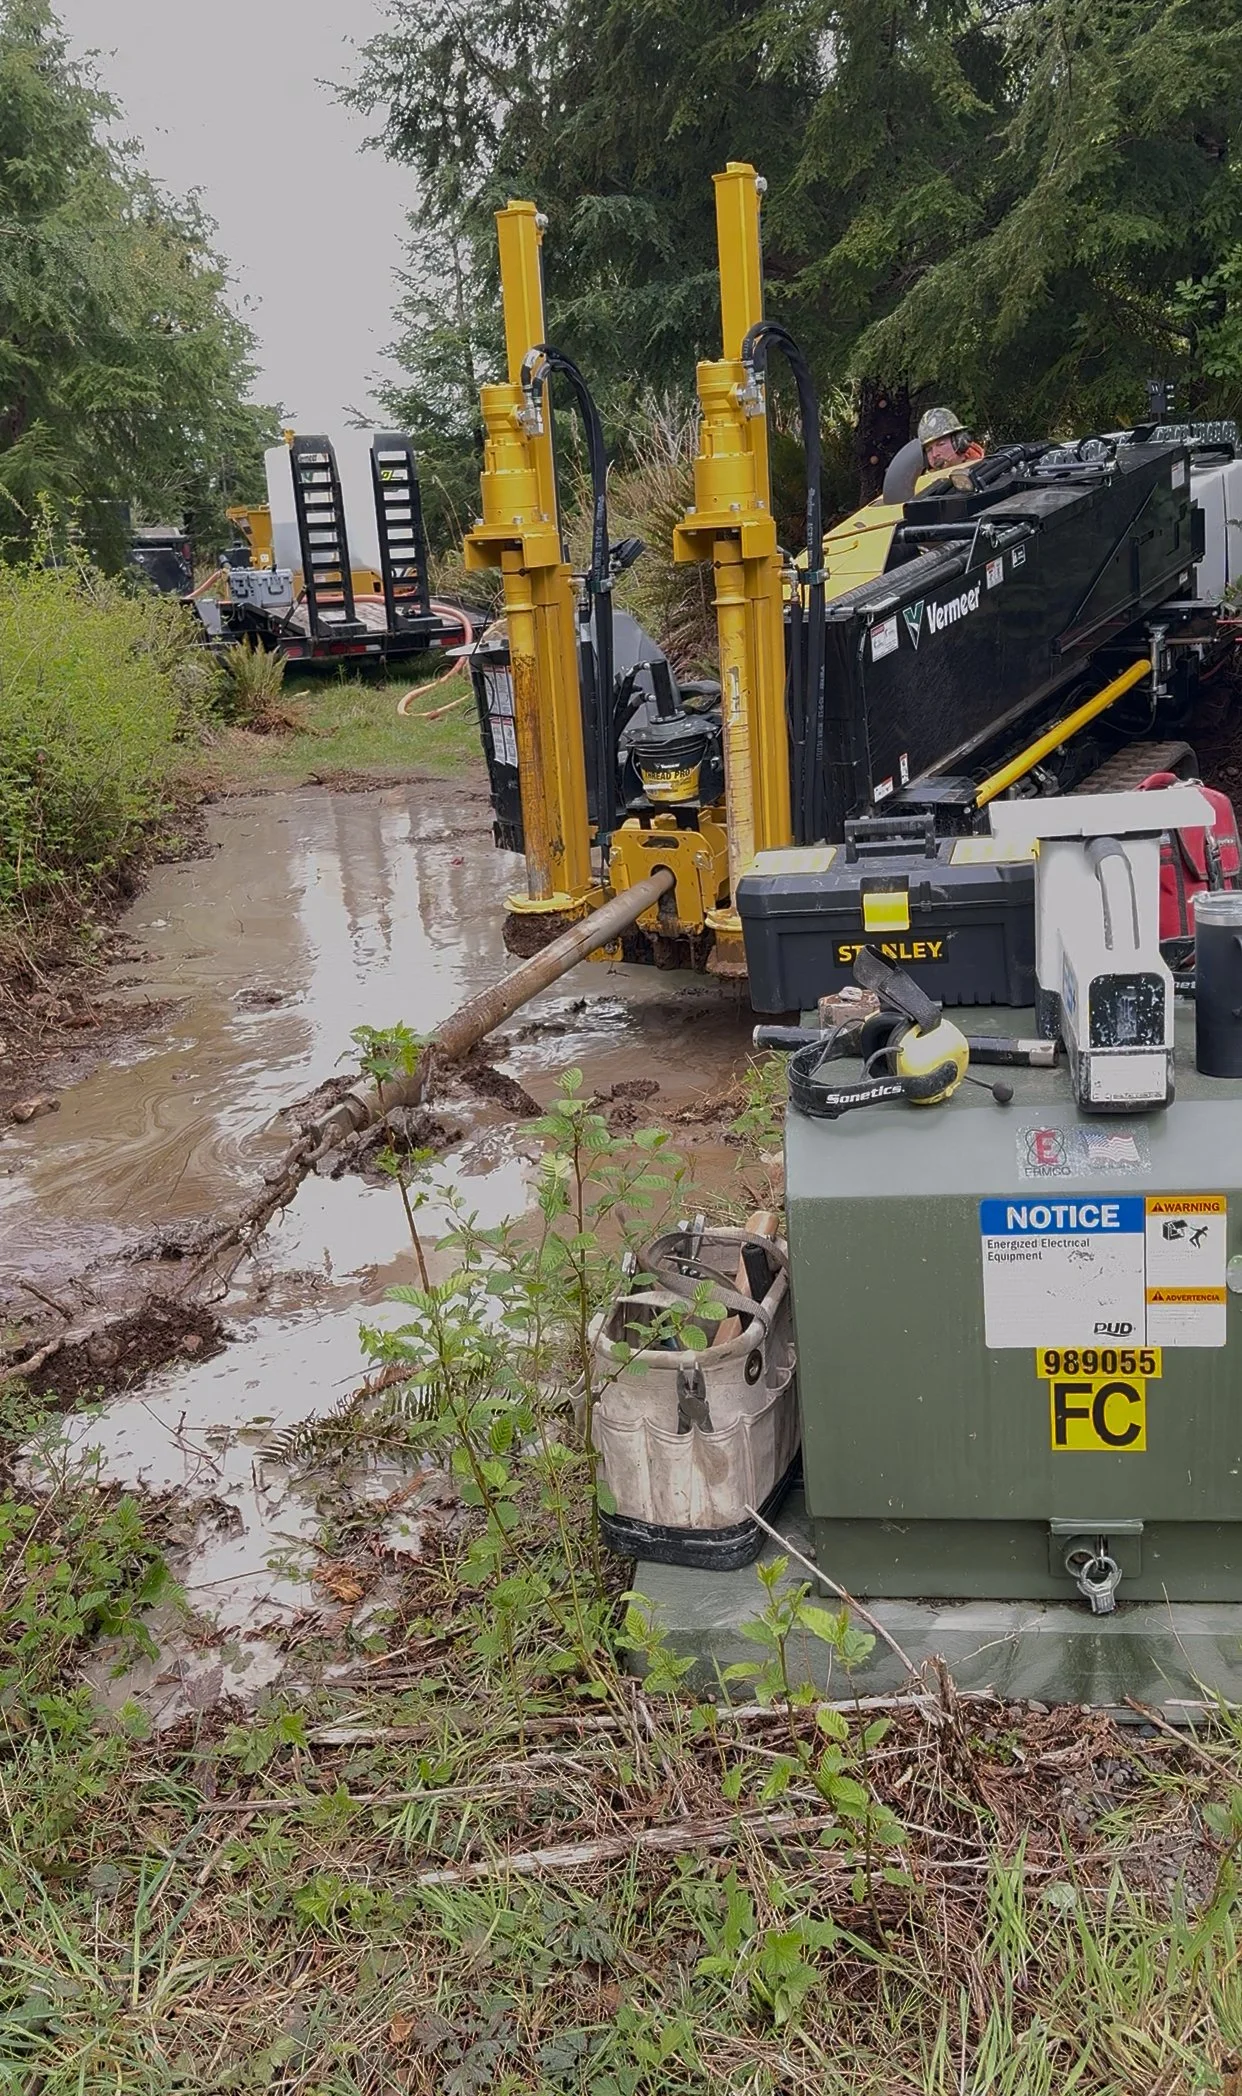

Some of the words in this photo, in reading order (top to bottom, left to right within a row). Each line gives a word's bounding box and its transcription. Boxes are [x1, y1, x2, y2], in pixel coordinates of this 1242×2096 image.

[926, 586, 980, 635] Vermeer
[838, 941, 942, 962] STNLEY
[826, 1085, 902, 1105] Sonetics
[1007, 1204, 1120, 1230] NOTICE
[1164, 1202, 1220, 1212] WARNING
[987, 1238, 1038, 1250] Energized
[1041, 1238, 1090, 1248] Electrical
[987, 1251, 1043, 1263] Equipment
[1165, 1294, 1220, 1302] ADVERTENCIA
[1093, 1322, 1133, 1336] PUD
[1044, 1349, 1156, 1375] 989055
[1054, 1381, 1142, 1447] FC
